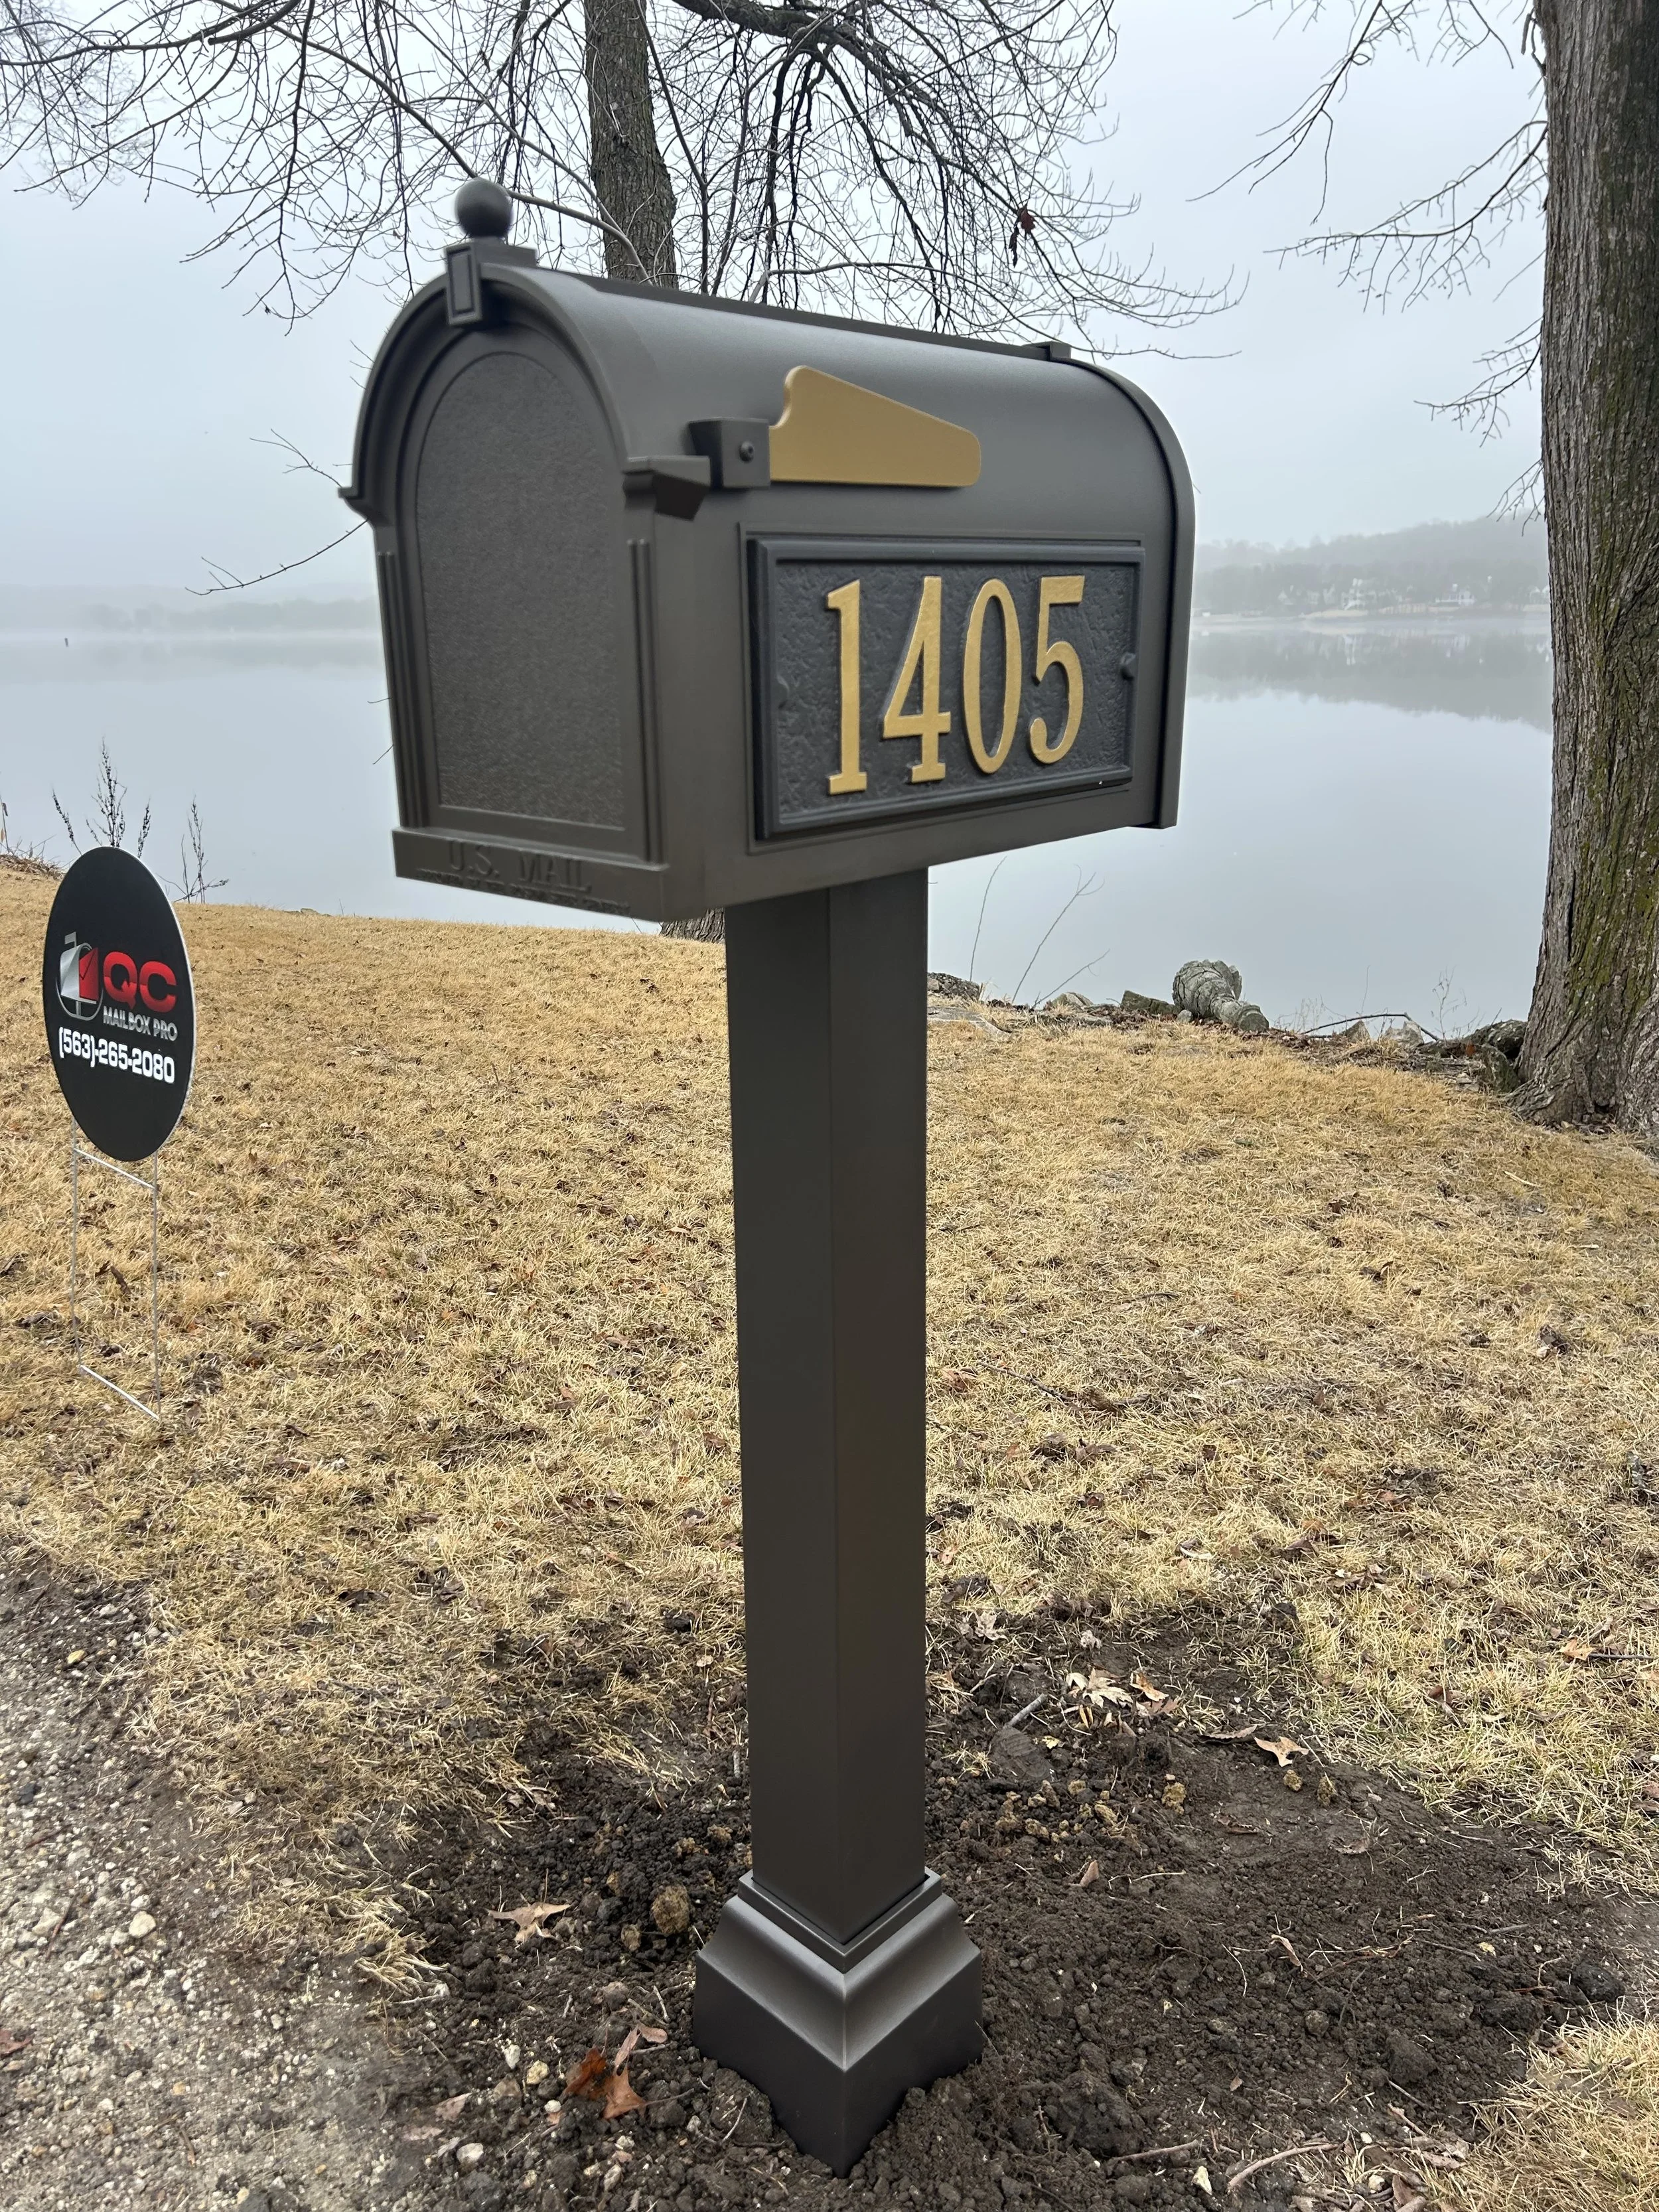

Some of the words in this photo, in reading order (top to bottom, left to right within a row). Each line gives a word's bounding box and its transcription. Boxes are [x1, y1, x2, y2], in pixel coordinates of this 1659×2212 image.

[827, 575, 1085, 795] 1405
[448, 840, 501, 879] U.S.
[517, 850, 593, 894] MAIL
[103, 951, 177, 1012] QC
[58, 1026, 175, 1084] (563)-265-2080
[153, 1017, 179, 1041] PRO
